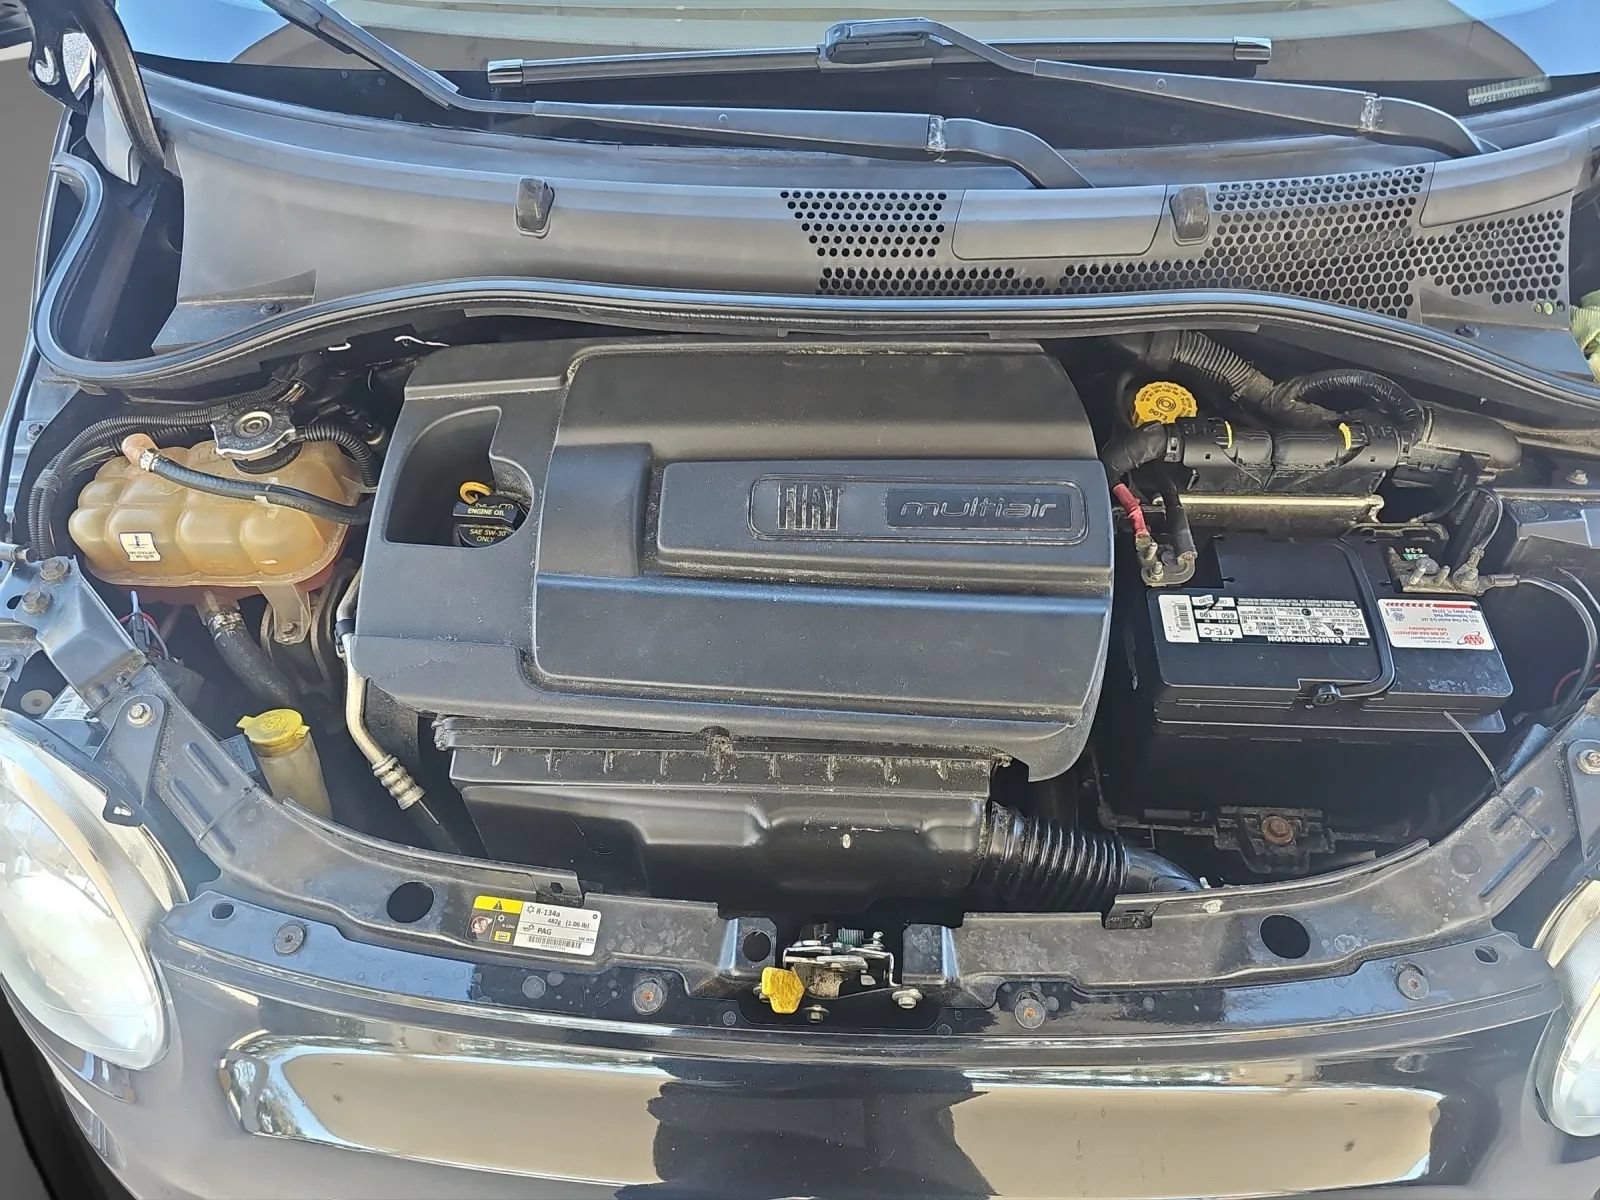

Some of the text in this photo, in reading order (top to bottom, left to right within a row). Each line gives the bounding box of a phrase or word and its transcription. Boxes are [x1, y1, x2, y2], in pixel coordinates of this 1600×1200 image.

[1147, 408, 1168, 421] DOT3
[467, 507, 493, 515] ENGINE
[900, 496, 1056, 518] multiair
[484, 529, 507, 537] 5W-30
[1267, 635, 1343, 644] DANGER/POISON
[1465, 635, 1482, 645] AAA
[536, 908, 561, 918] R-134a
[537, 927, 552, 936] PAG
